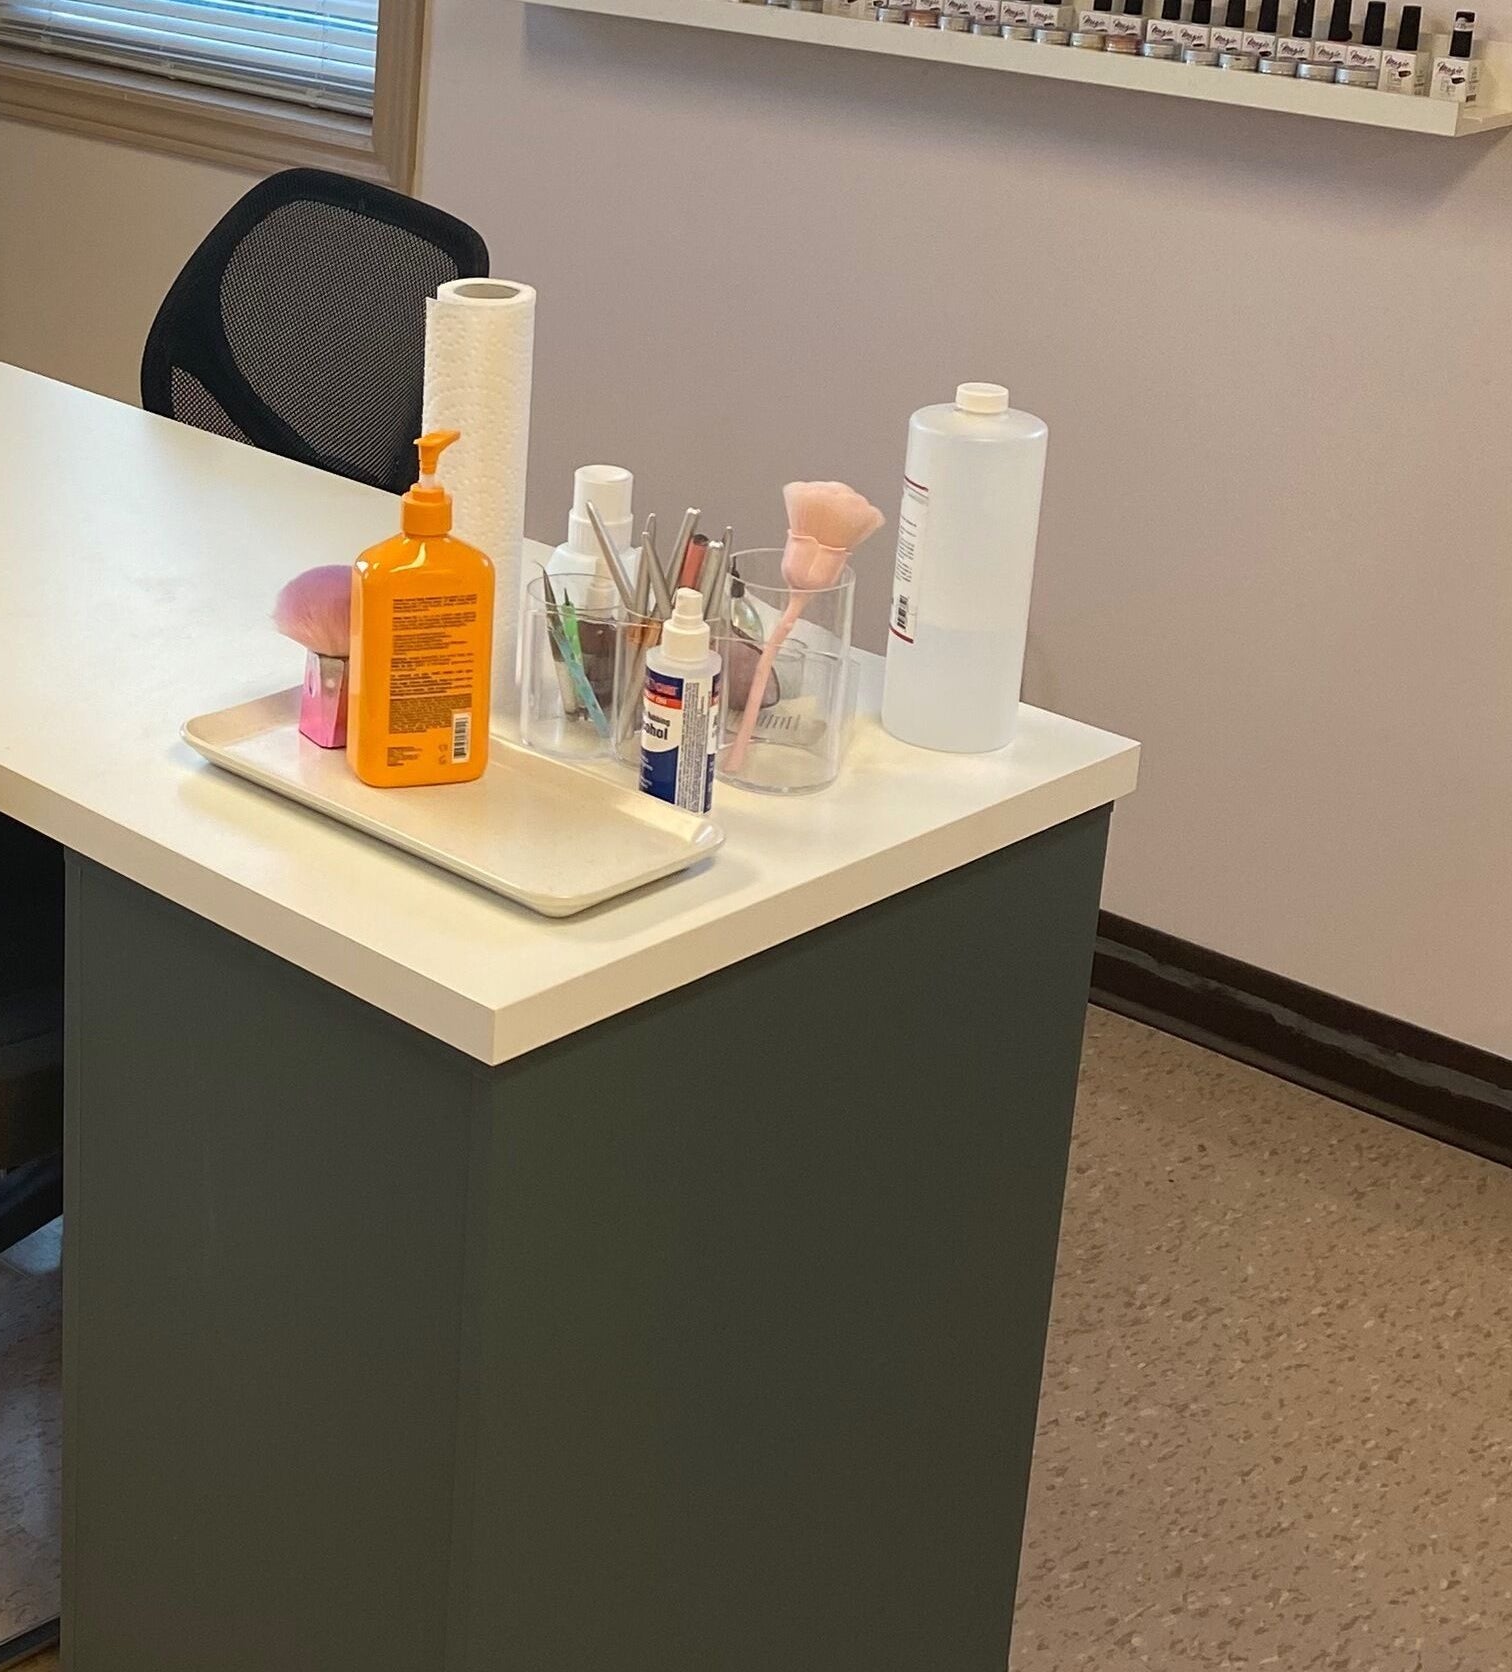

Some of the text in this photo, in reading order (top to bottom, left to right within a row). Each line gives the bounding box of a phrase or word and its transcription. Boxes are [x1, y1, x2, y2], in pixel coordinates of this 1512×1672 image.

[1113, 18, 1137, 32] Magic
[1150, 22, 1174, 37] Magic
[1180, 27, 1204, 41] Magic
[1213, 31, 1237, 46] Magic
[1280, 43, 1305, 57] Magic
[1317, 45, 1341, 61] Magic
[1350, 51, 1375, 65] Magic
[1384, 55, 1409, 70] Magic
[1437, 60, 1465, 76] Magic
